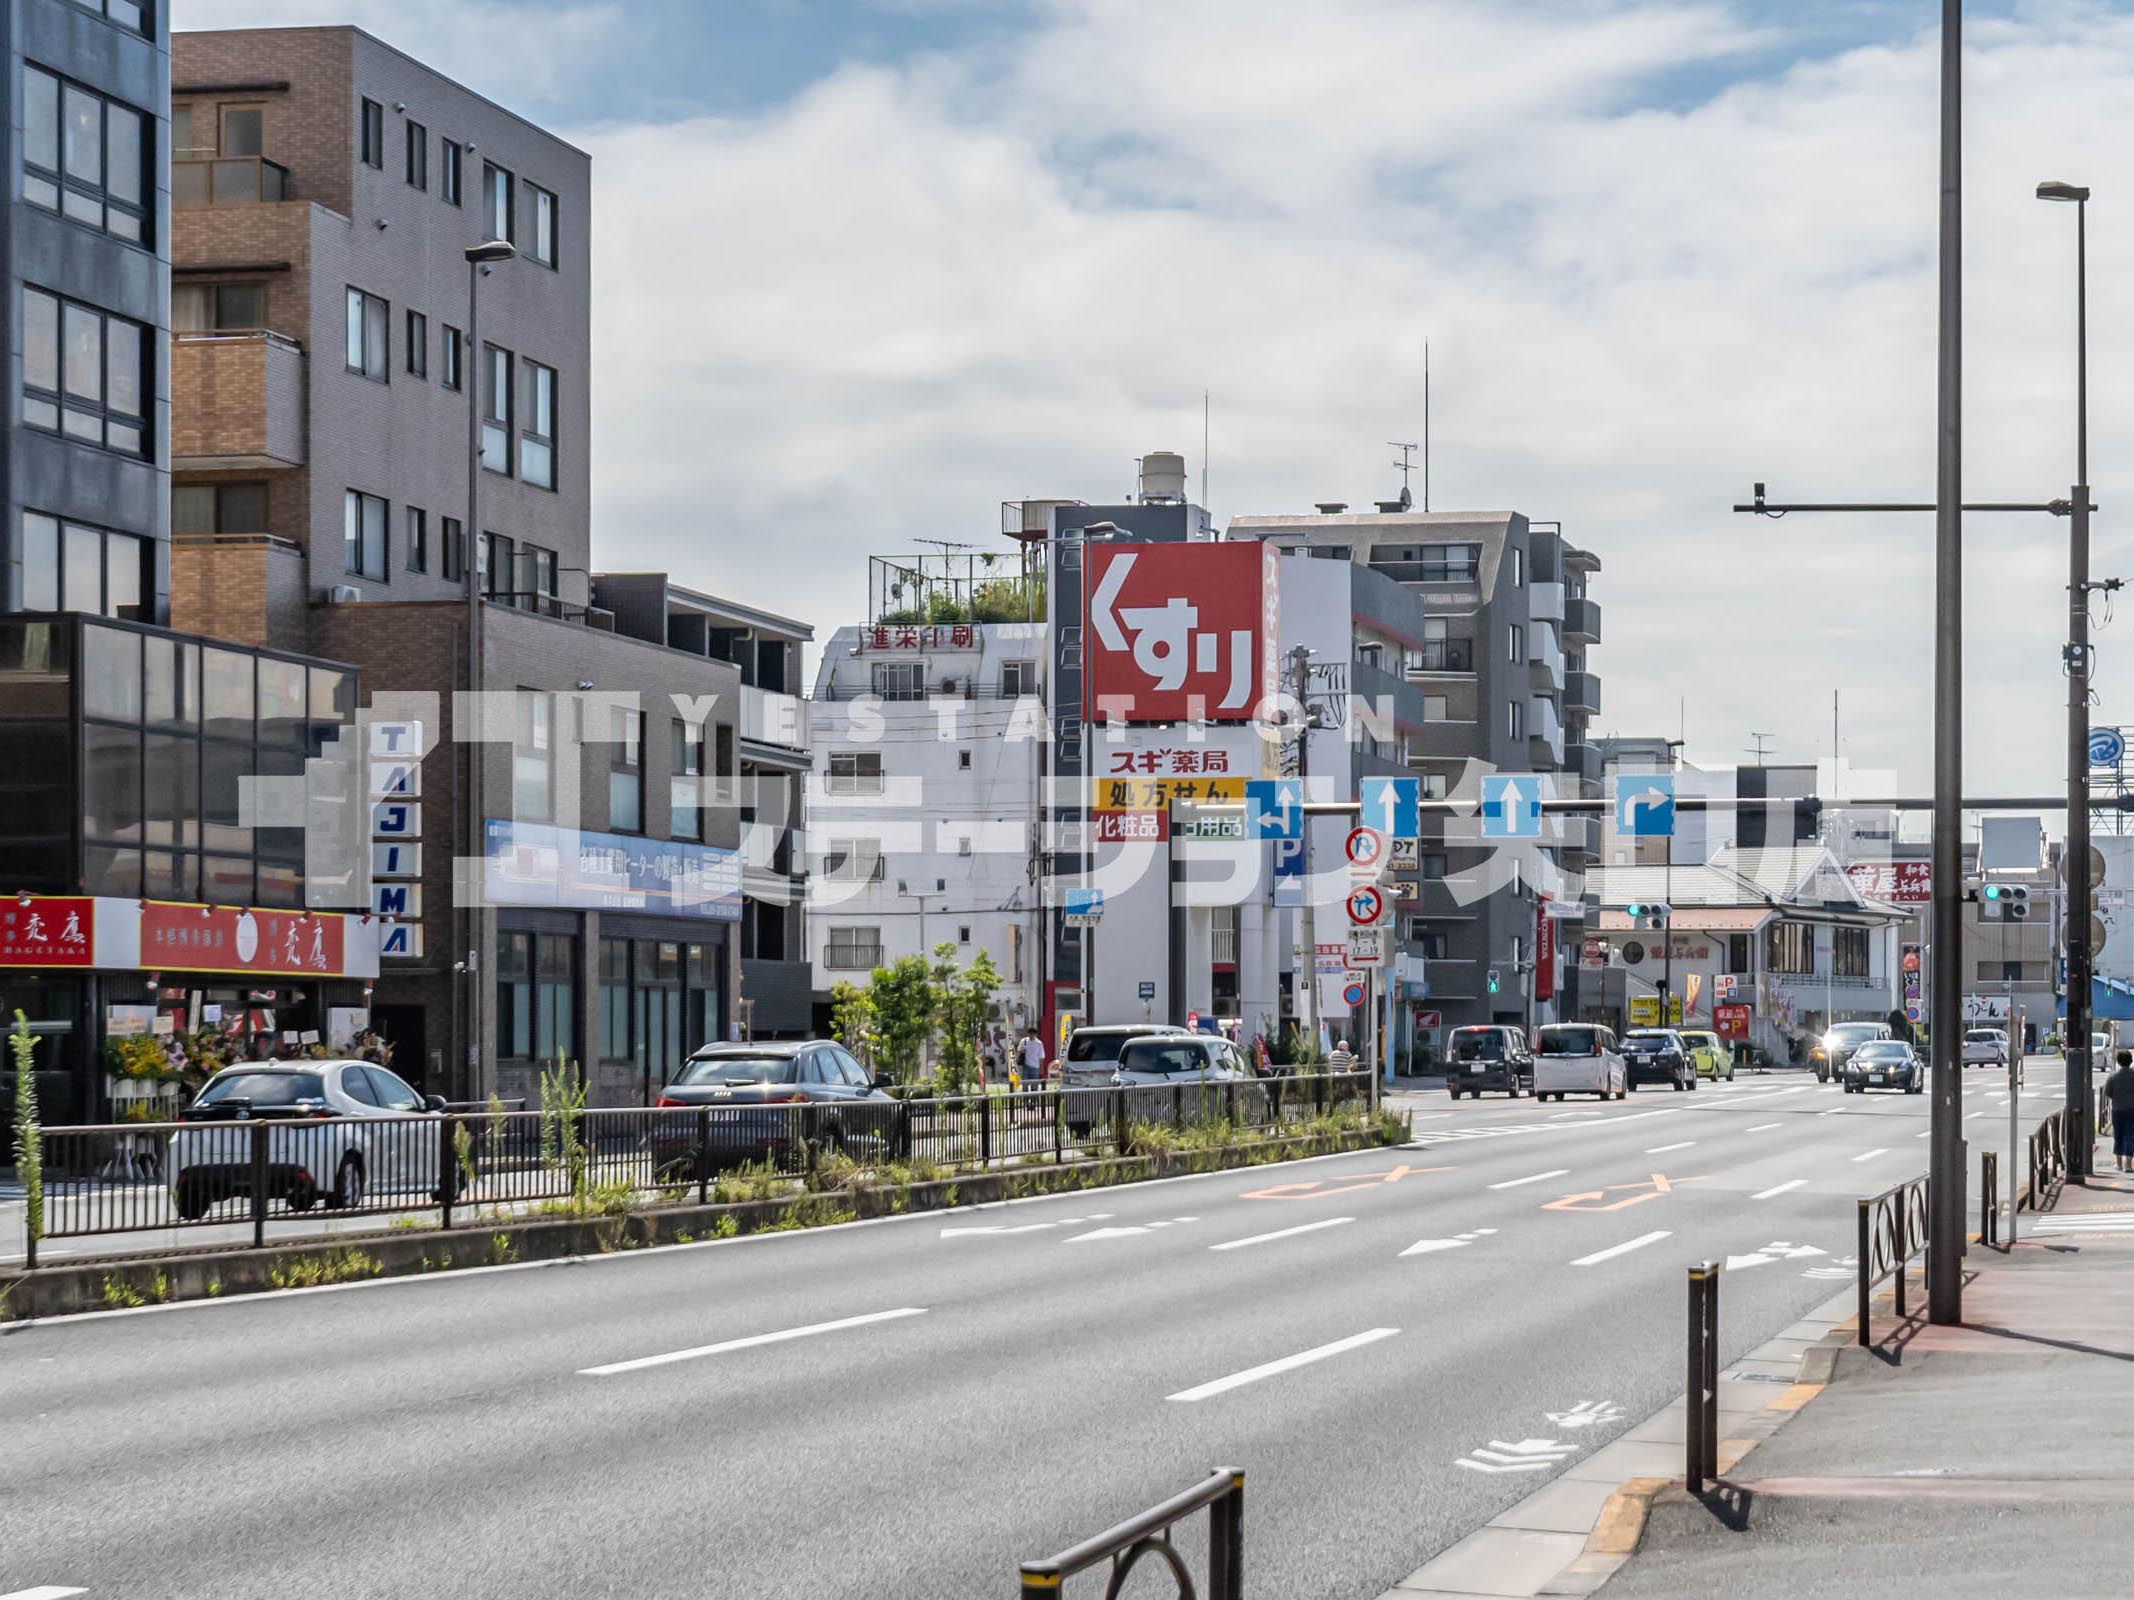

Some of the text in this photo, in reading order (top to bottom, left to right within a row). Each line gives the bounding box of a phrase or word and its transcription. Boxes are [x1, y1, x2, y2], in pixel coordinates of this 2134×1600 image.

[867, 625, 973, 648] 進栄印刷
[1091, 553, 1252, 709] くすり
[1110, 748, 1228, 773] スギ薬局
[1110, 781, 1228, 807] 処方せん
[1096, 815, 1159, 837] 化粧品
[380, 726, 407, 952] TAJIMA
[1277, 840, 1301, 867] P
[1725, 977, 1734, 987] P
[1731, 1019, 1742, 1033] P
